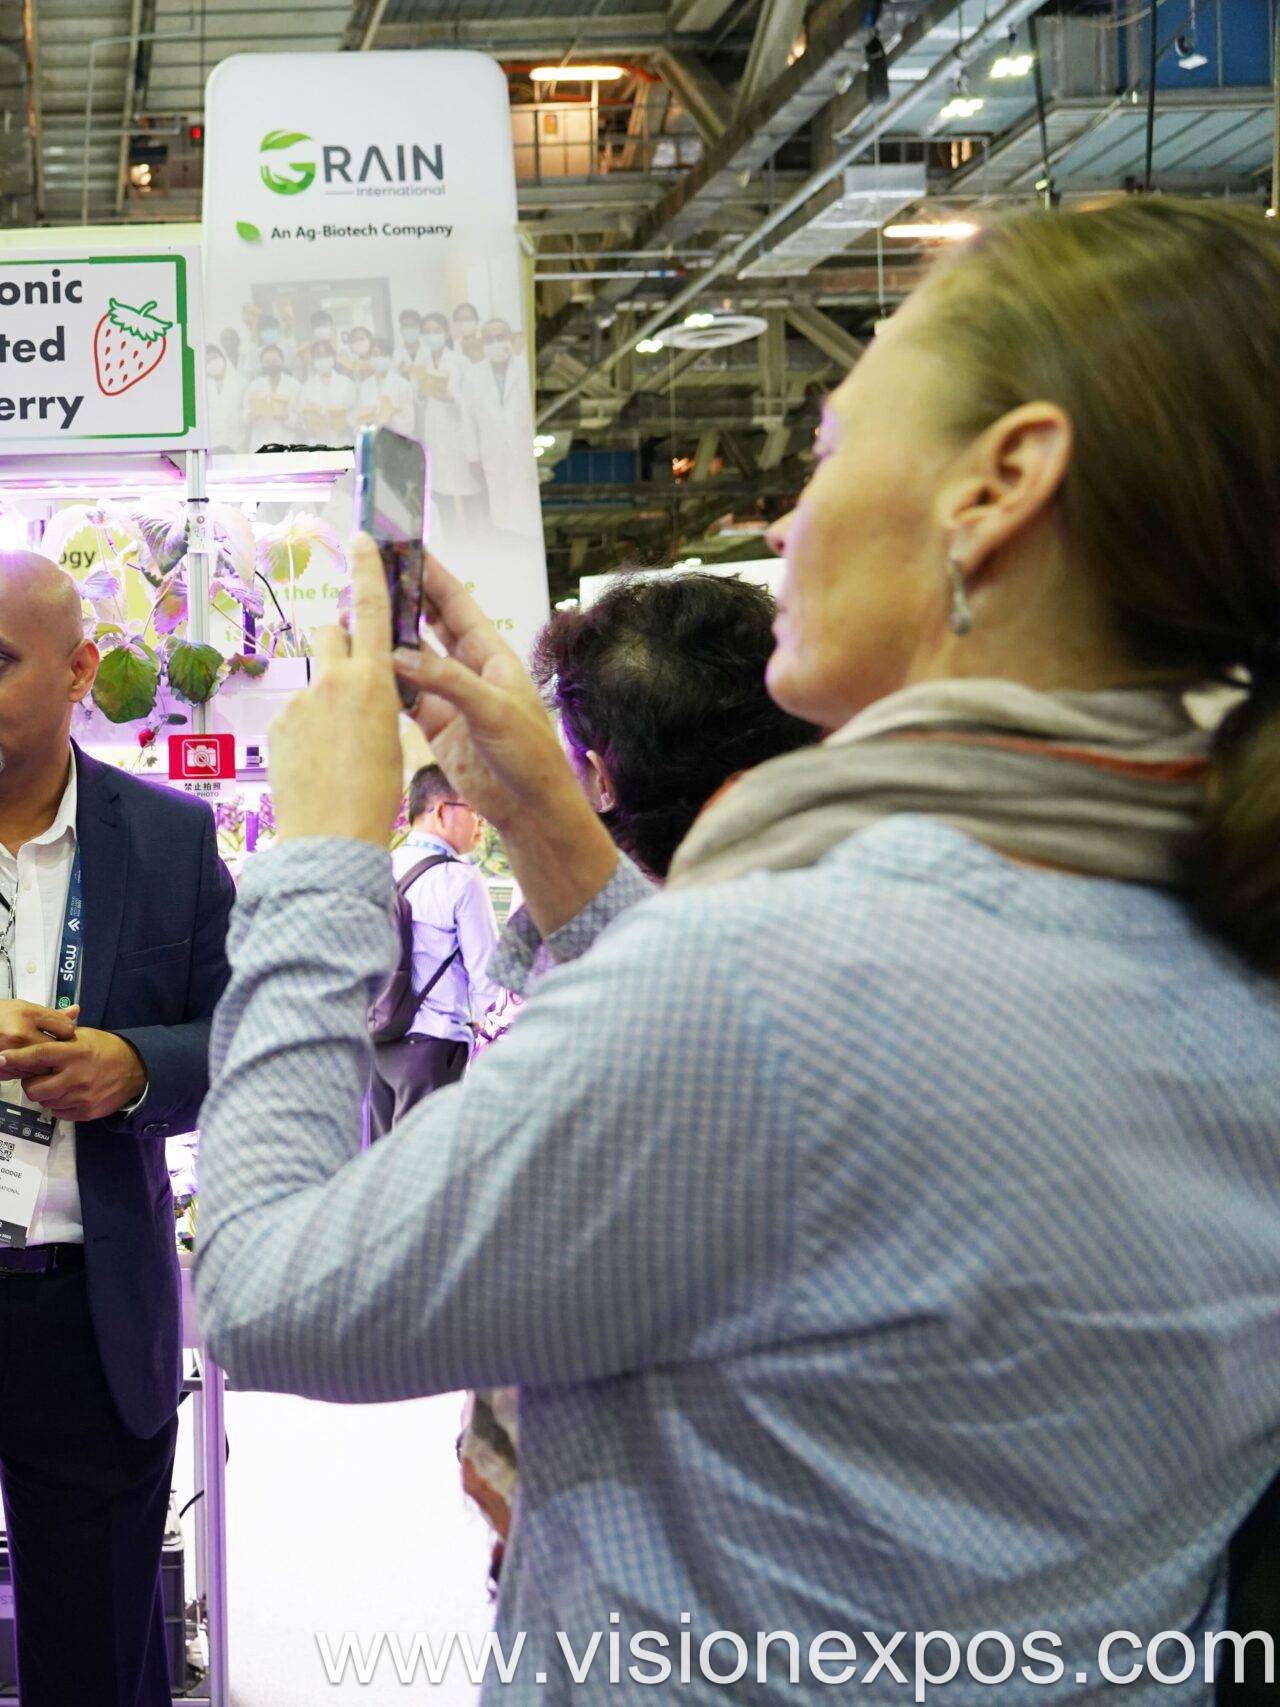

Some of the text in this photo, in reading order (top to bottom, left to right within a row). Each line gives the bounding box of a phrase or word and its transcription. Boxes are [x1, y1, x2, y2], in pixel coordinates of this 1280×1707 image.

[259, 128, 445, 195] GRAIN
[356, 184, 446, 197] International
[271, 221, 454, 241] An Ag-Biotech Company
[0, 1167, 23, 1179] GODGE
